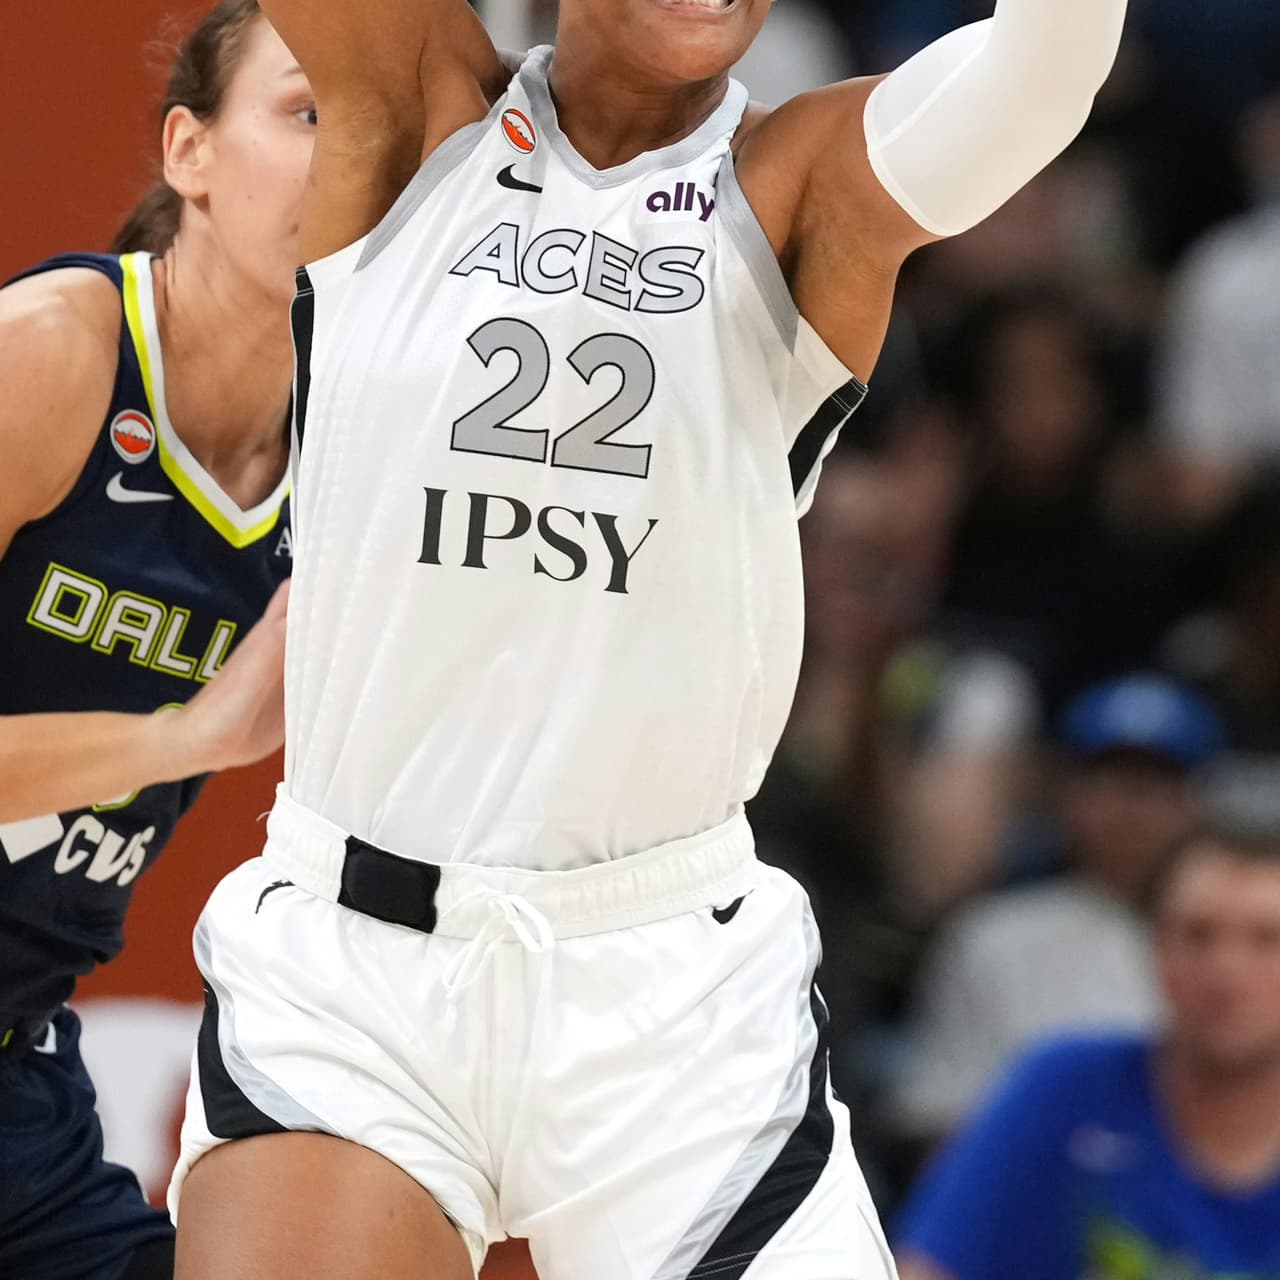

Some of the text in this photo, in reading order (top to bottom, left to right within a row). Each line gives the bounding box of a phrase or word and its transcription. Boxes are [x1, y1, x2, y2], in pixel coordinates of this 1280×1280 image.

[646, 182, 715, 222] ally
[450, 222, 705, 313] ACES
[450, 317, 656, 478] 22
[417, 487, 659, 594] IPSY
[54, 814, 155, 886] CVS
